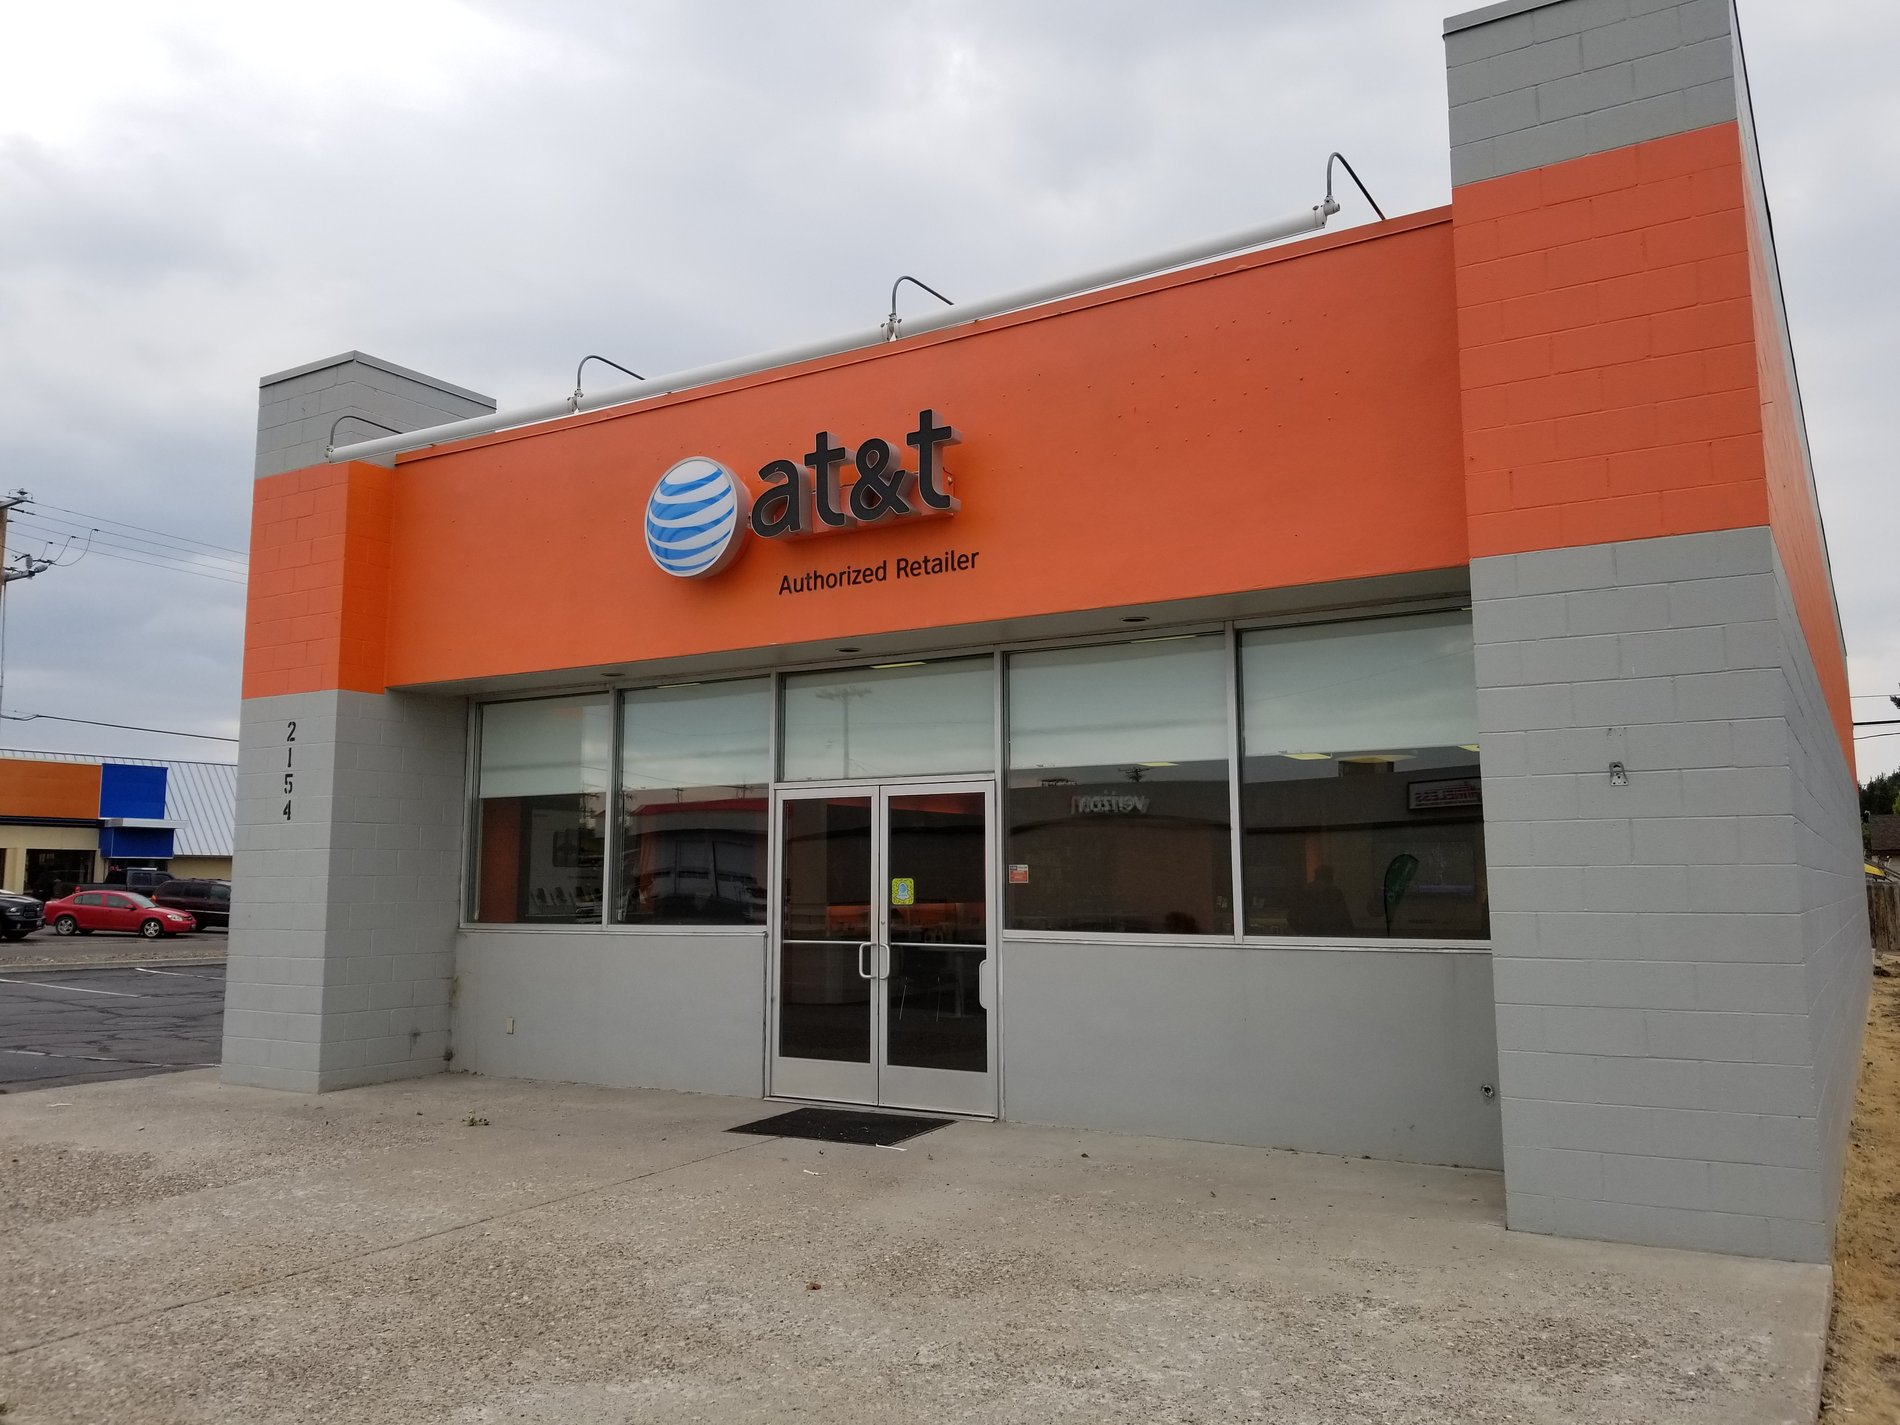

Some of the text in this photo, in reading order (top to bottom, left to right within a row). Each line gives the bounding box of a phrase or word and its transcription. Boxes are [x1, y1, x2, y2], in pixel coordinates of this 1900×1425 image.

[751, 408, 956, 538] at&t
[778, 549, 980, 596] Authorized Retailer
[282, 721, 297, 821] 2154
